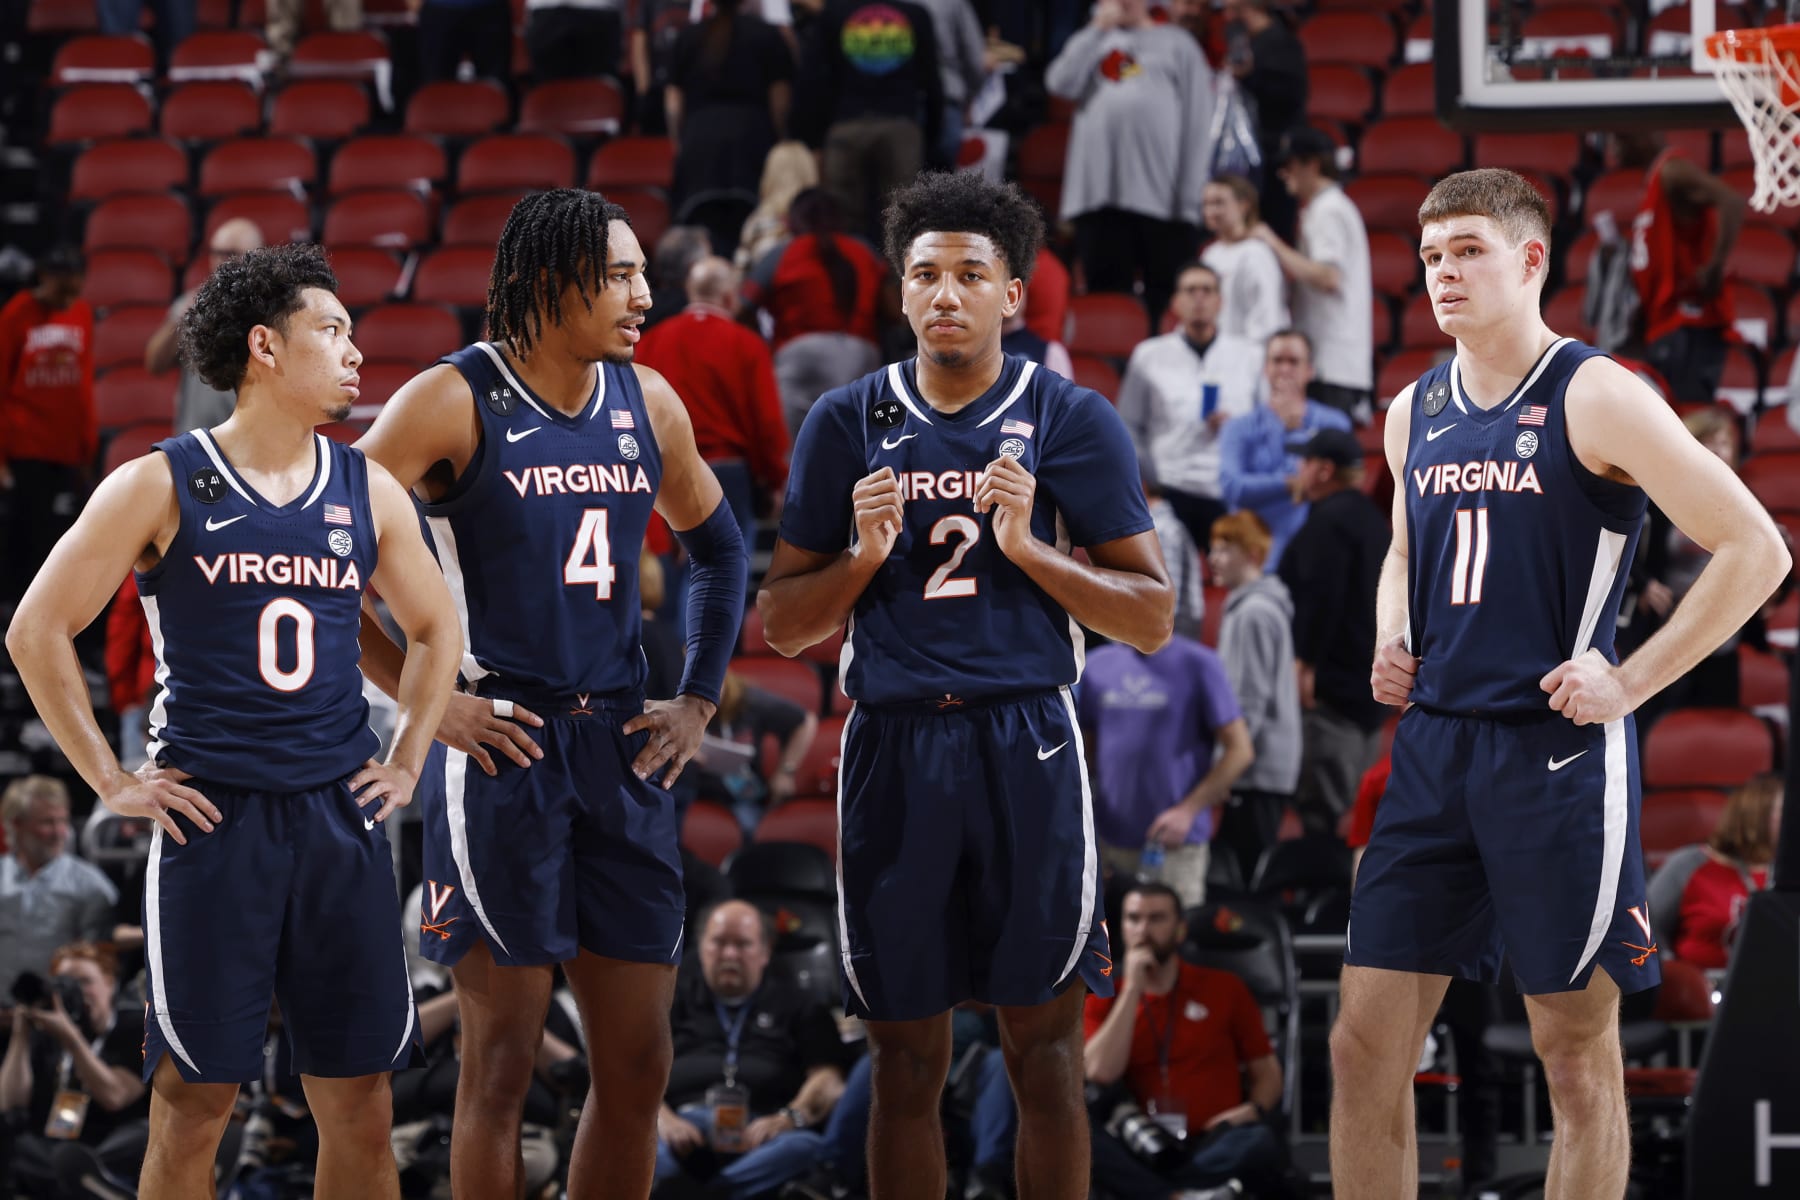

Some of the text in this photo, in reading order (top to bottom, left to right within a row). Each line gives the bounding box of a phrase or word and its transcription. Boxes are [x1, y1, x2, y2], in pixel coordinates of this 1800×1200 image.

[503, 464, 652, 499] VIRGINIA
[1413, 460, 1544, 498] VIRGINIA
[193, 552, 361, 591] VIRGINIA
[564, 507, 616, 601] 4
[923, 513, 981, 601] 2
[1450, 507, 1490, 606] 11
[257, 596, 316, 693] 0
